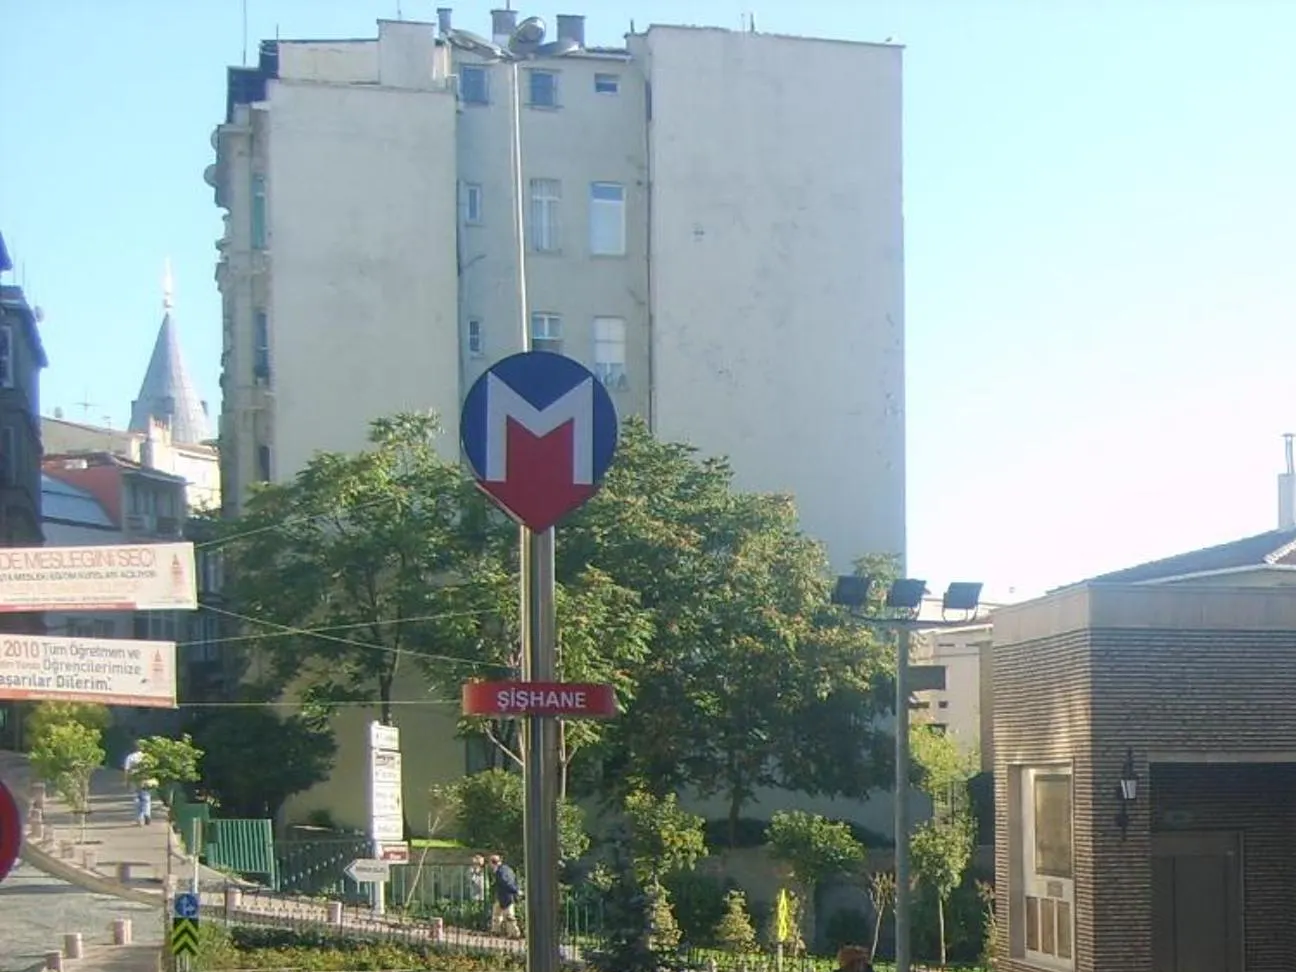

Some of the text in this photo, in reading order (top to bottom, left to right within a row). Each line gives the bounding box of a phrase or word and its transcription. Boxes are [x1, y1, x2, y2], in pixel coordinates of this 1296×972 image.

[486, 370, 594, 485] M
[4, 640, 39, 658] 2010
[497, 687, 586, 711] ŞİŞHANE
